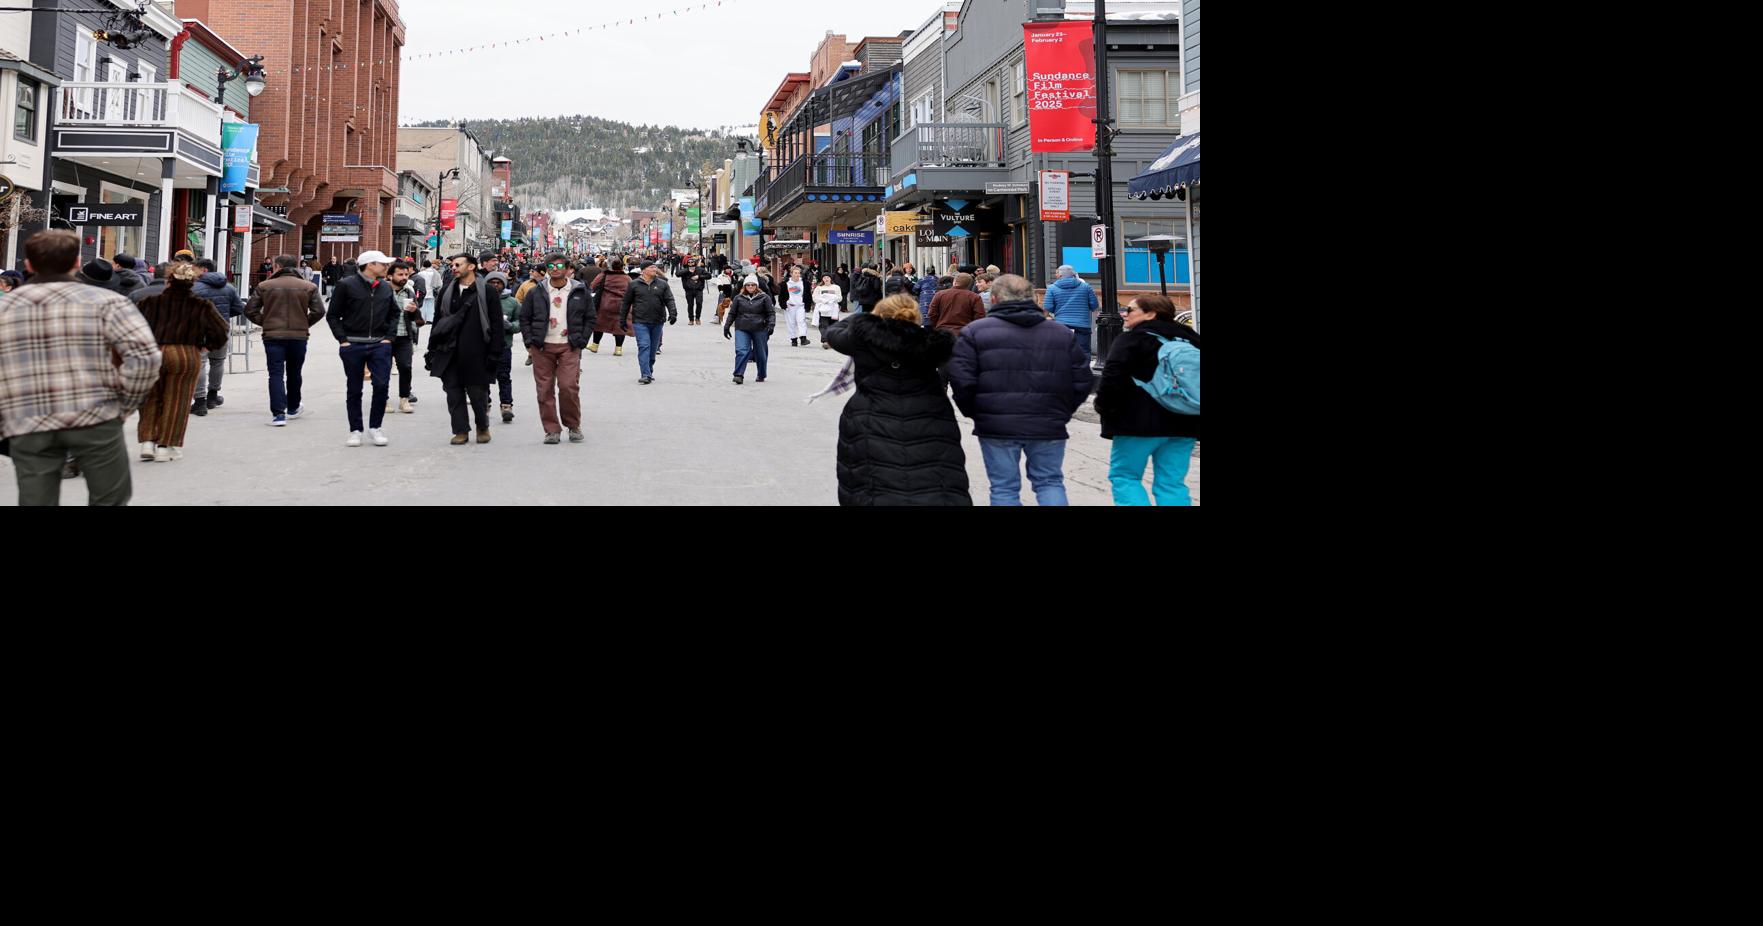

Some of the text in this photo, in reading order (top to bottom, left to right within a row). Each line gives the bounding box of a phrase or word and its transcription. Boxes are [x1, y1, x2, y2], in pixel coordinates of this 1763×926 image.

[1032, 72, 1089, 80] Sundance
[1033, 81, 1062, 90] Film
[1034, 90, 1090, 99] Festival
[1034, 100, 1063, 109] 2025
[940, 213, 975, 221] VULTURE
